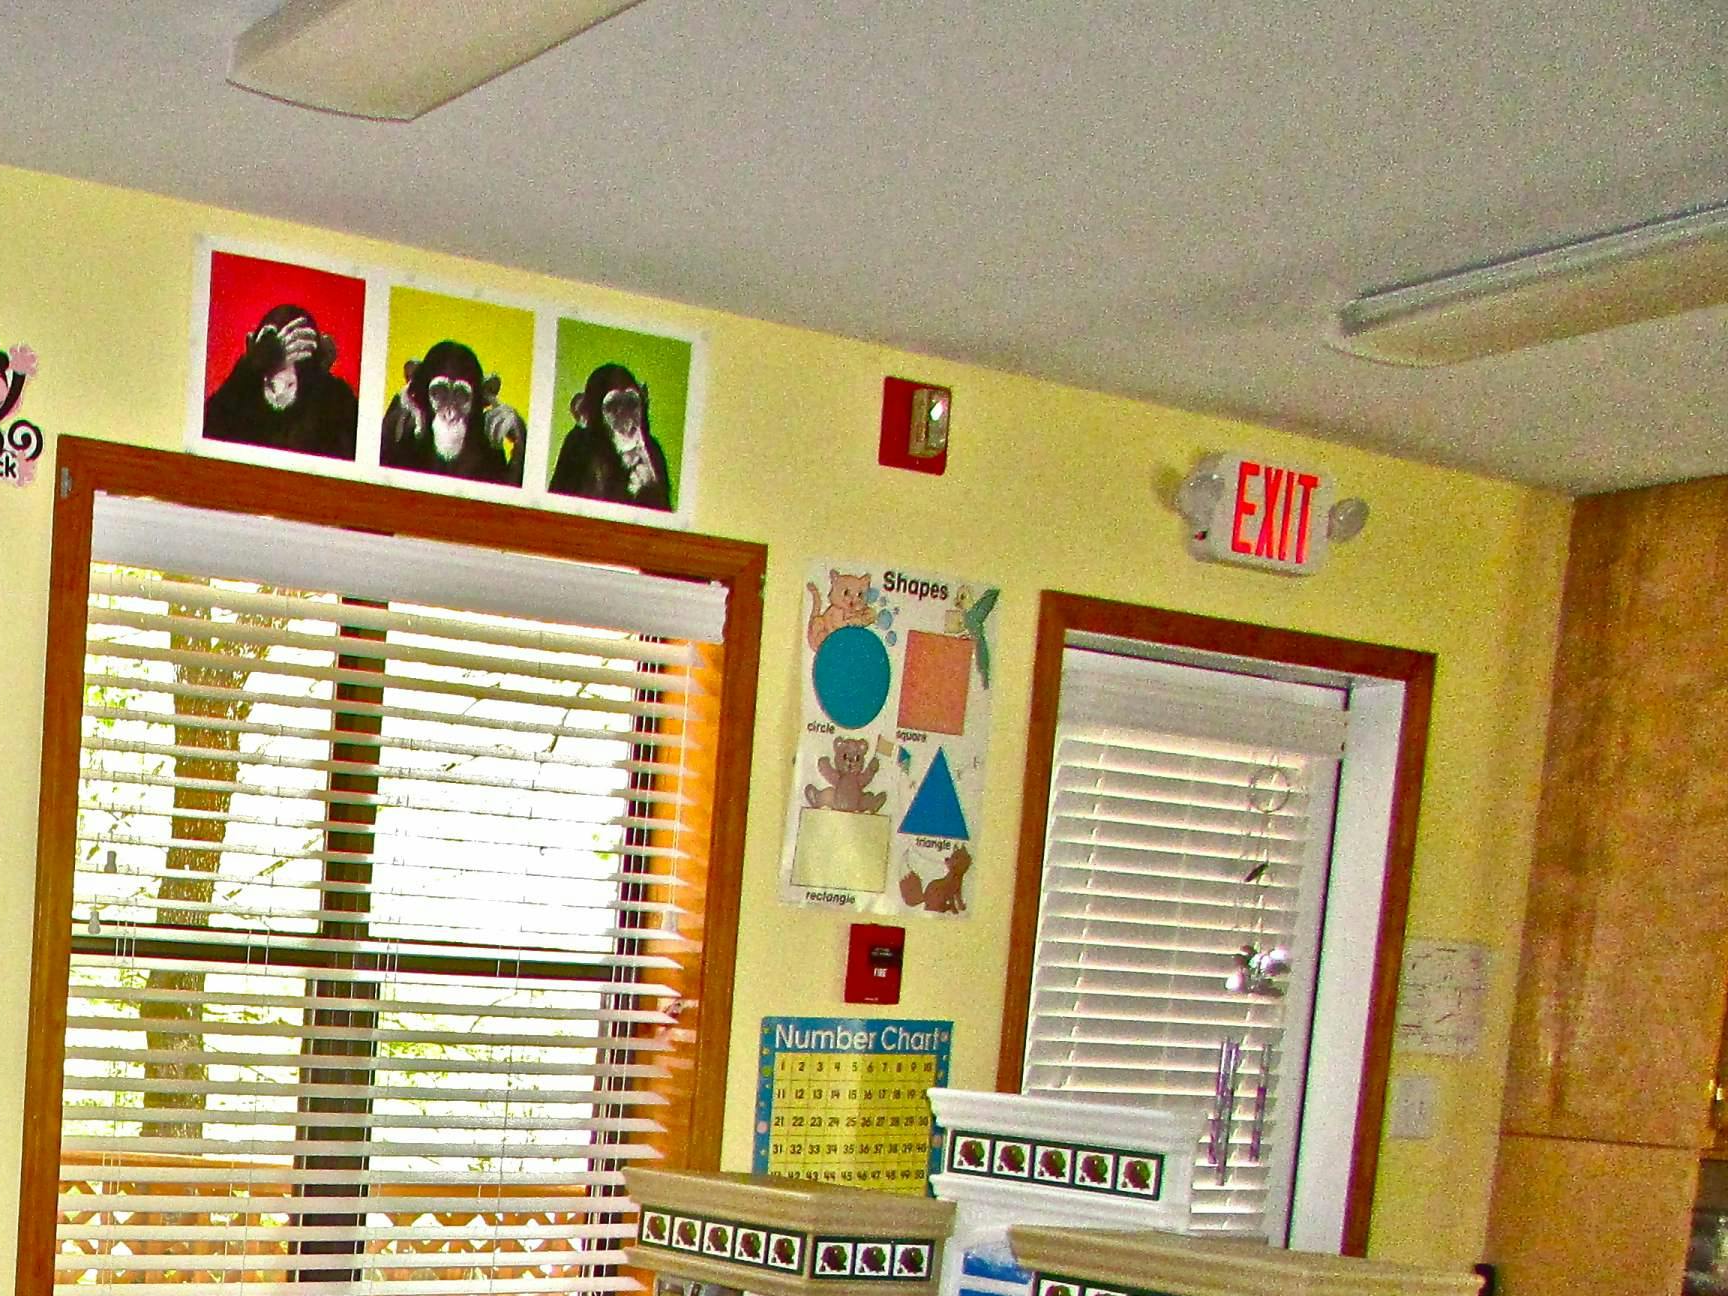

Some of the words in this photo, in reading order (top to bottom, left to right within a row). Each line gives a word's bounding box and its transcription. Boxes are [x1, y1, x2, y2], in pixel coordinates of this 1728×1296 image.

[1230, 460, 1321, 564] EXIT
[882, 570, 949, 601] Shapes
[807, 720, 836, 735] circle
[896, 728, 928, 743] square
[916, 836, 952, 852] triangle
[805, 890, 856, 906] rectangle
[775, 1024, 876, 1051] Number
[881, 1026, 940, 1051] Chart
